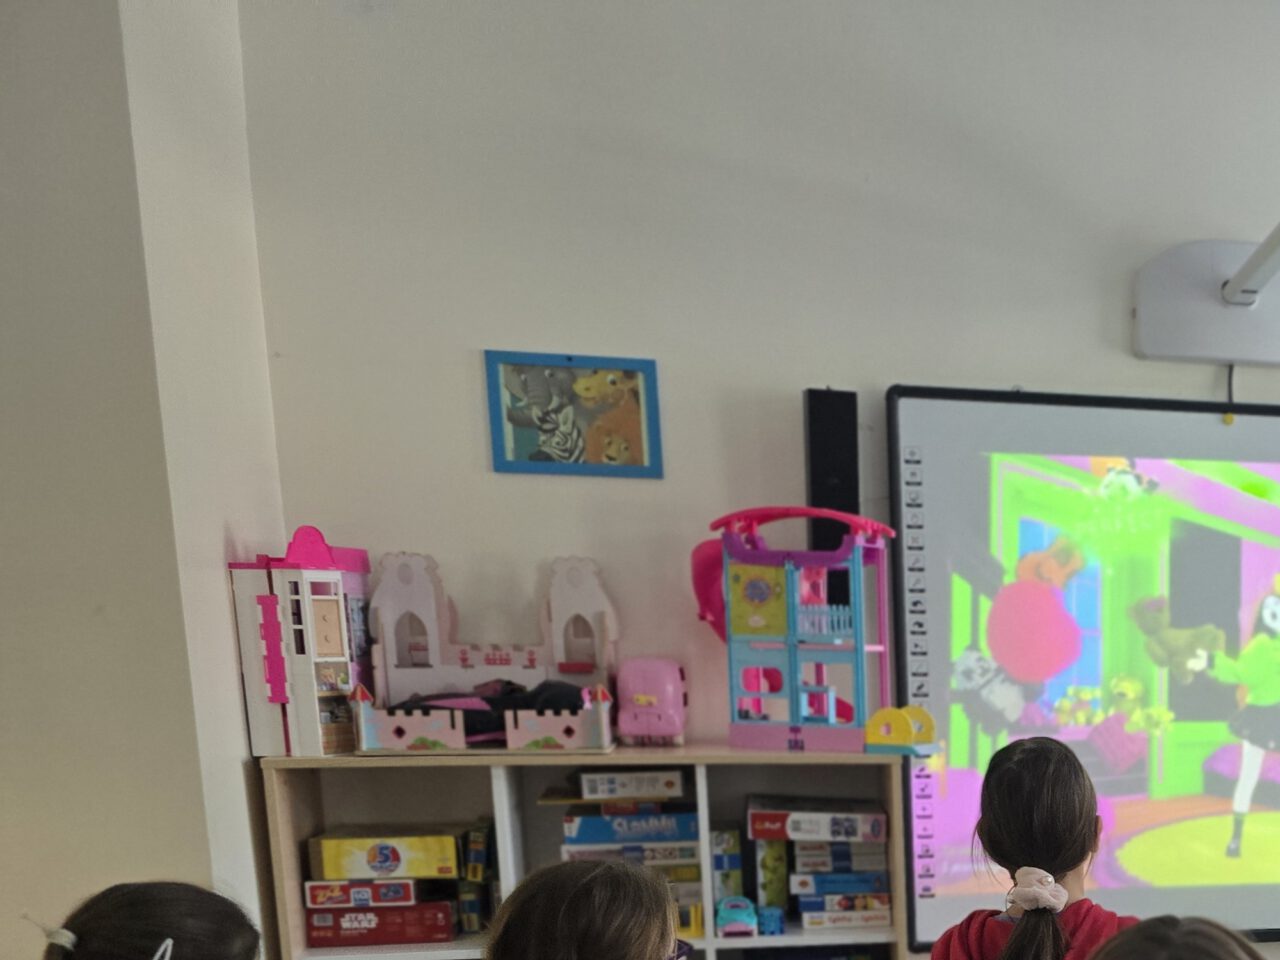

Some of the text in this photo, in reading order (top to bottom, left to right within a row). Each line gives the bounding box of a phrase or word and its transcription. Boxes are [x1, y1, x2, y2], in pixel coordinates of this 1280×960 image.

[377, 845, 391, 864] 5
[341, 912, 377, 921] STAR
[341, 920, 377, 929] WARS
